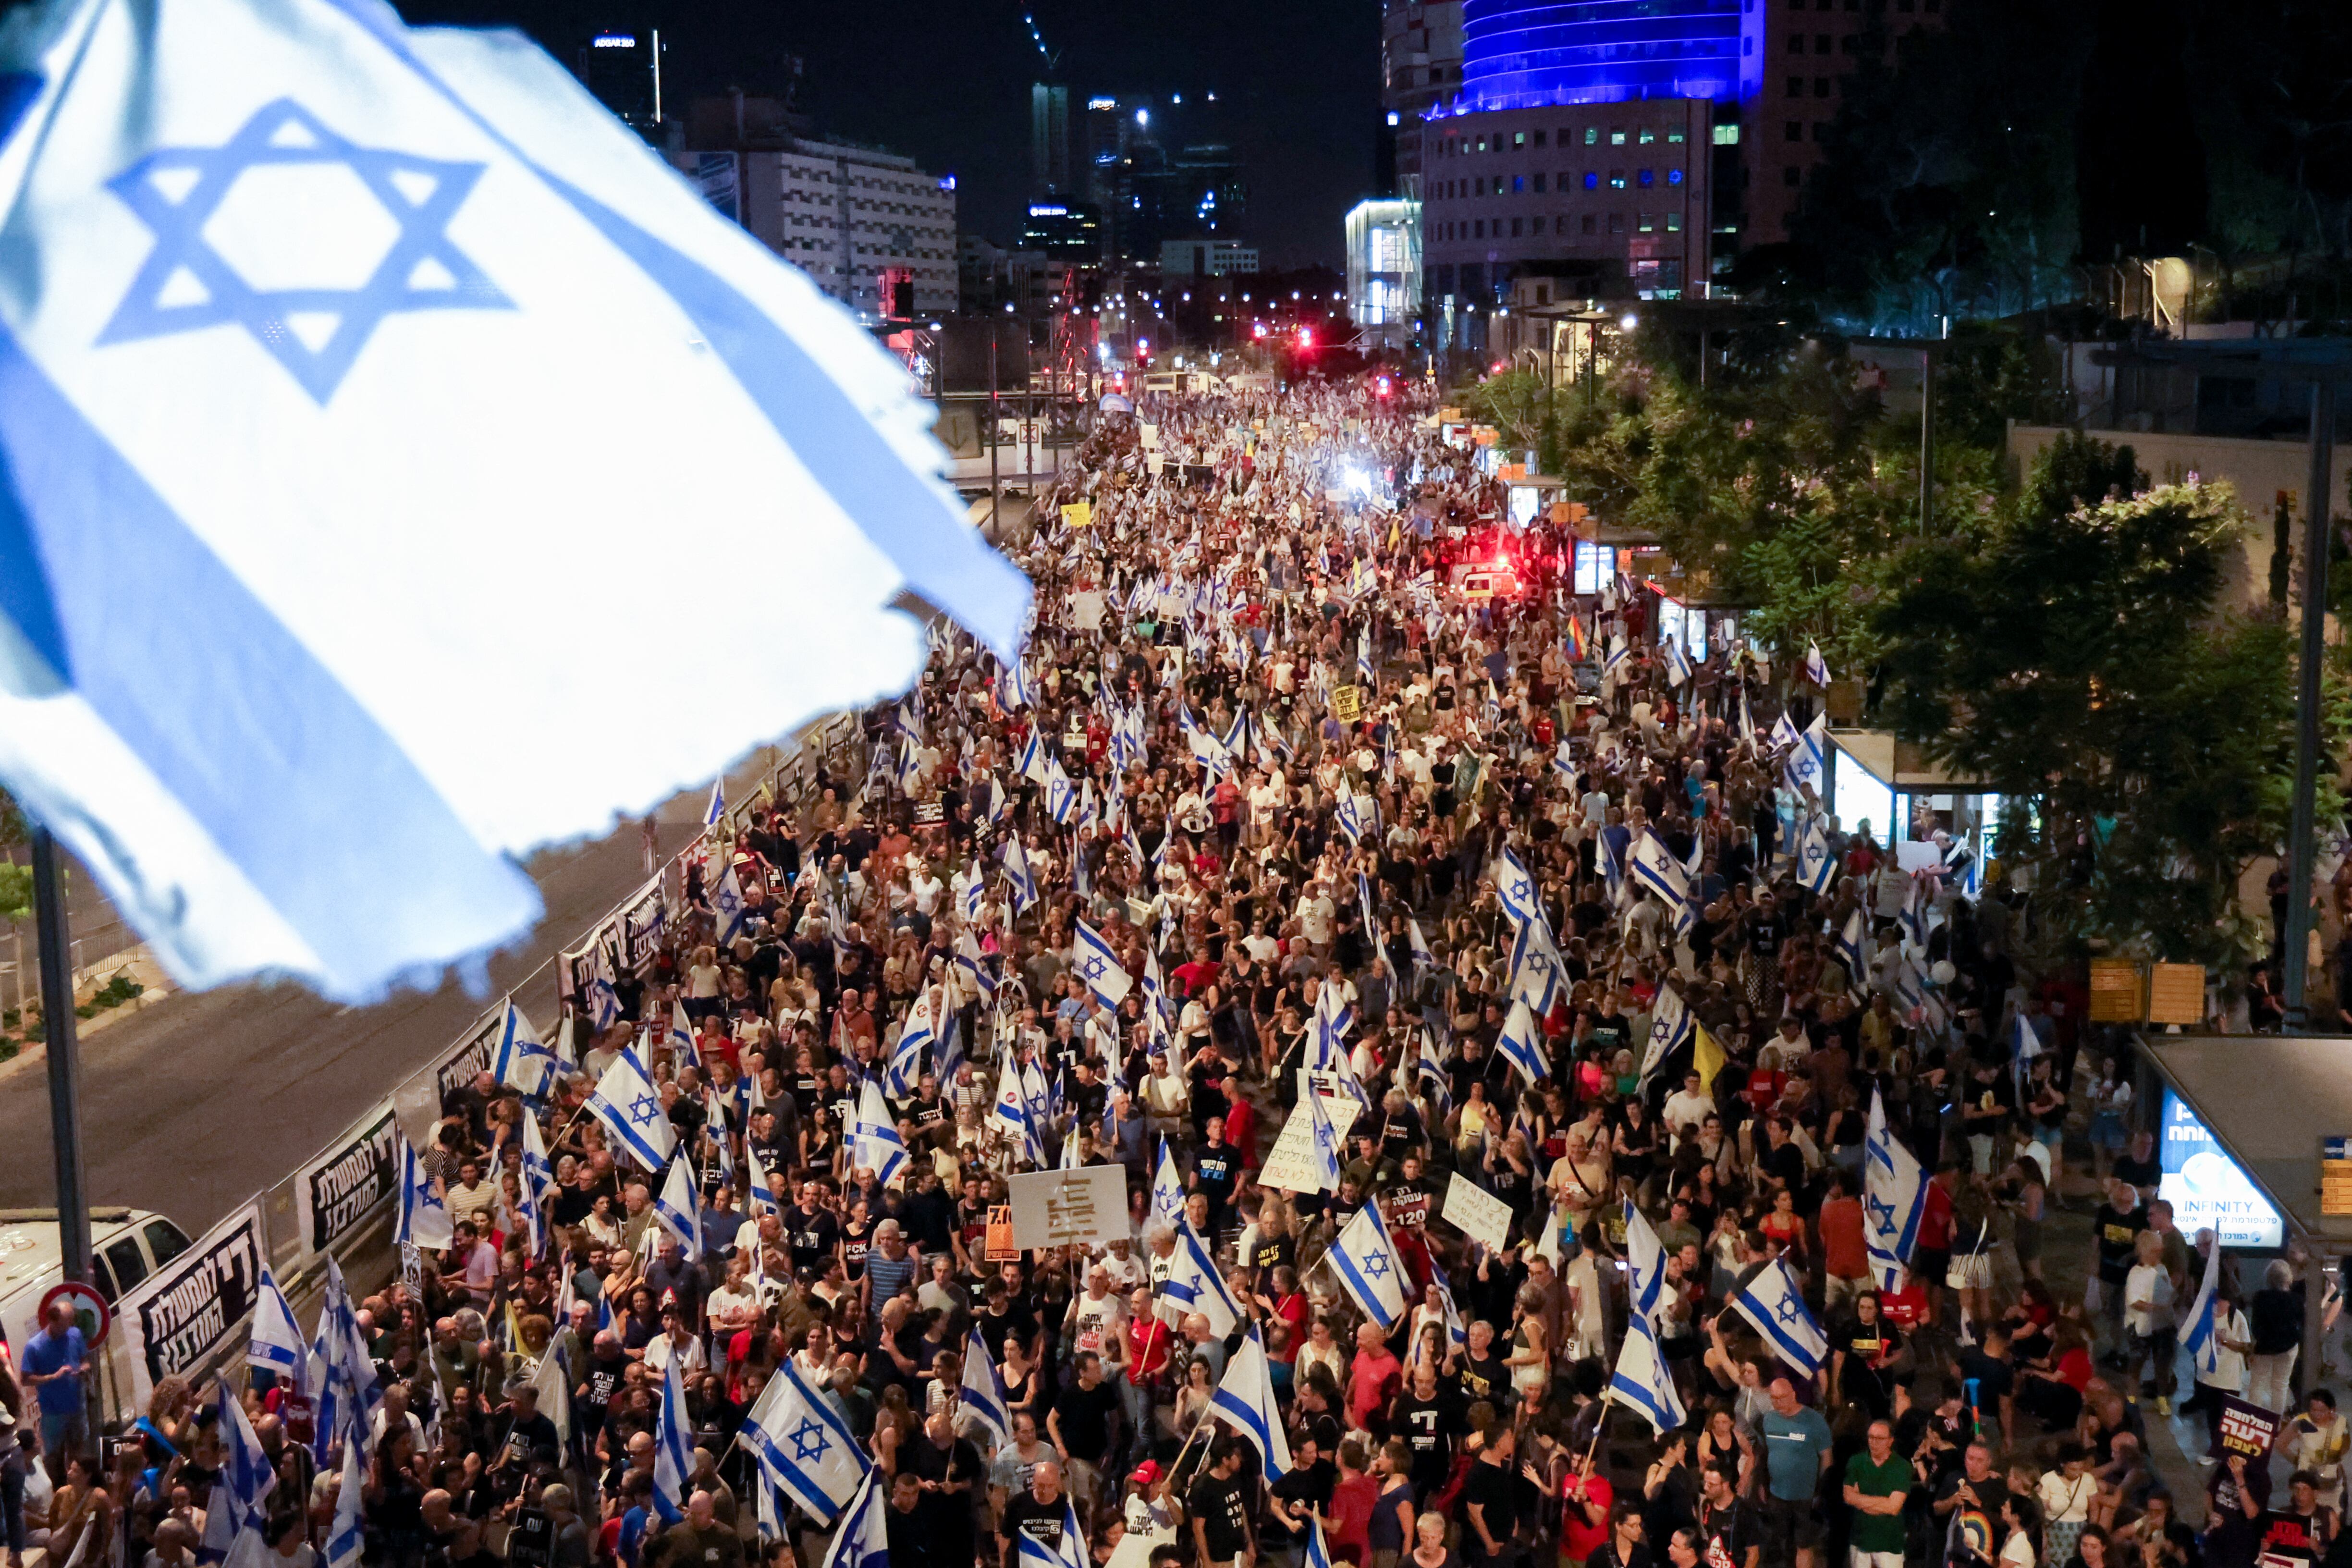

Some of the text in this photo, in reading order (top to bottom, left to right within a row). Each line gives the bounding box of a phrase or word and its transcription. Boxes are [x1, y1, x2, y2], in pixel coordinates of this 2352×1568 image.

[595, 38, 635, 47] ADGAR 360
[1200, 1159, 1227, 1172] חופשי
[318, 1139, 375, 1209] לממשלת
[1396, 1186, 1411, 1196] רק
[1392, 1192, 1422, 1207] עסקה
[2184, 1201, 2253, 1212] INFINITY
[1396, 1209, 1426, 1225] 120
[845, 1243, 867, 1253] FCK
[149, 1256, 217, 1344] לממשלת
[1084, 1313, 1102, 1323] אתה
[1410, 1410, 1437, 1430] די
[2225, 1408, 2273, 1432] המלחמה
[2221, 1418, 2271, 1448] רעה
